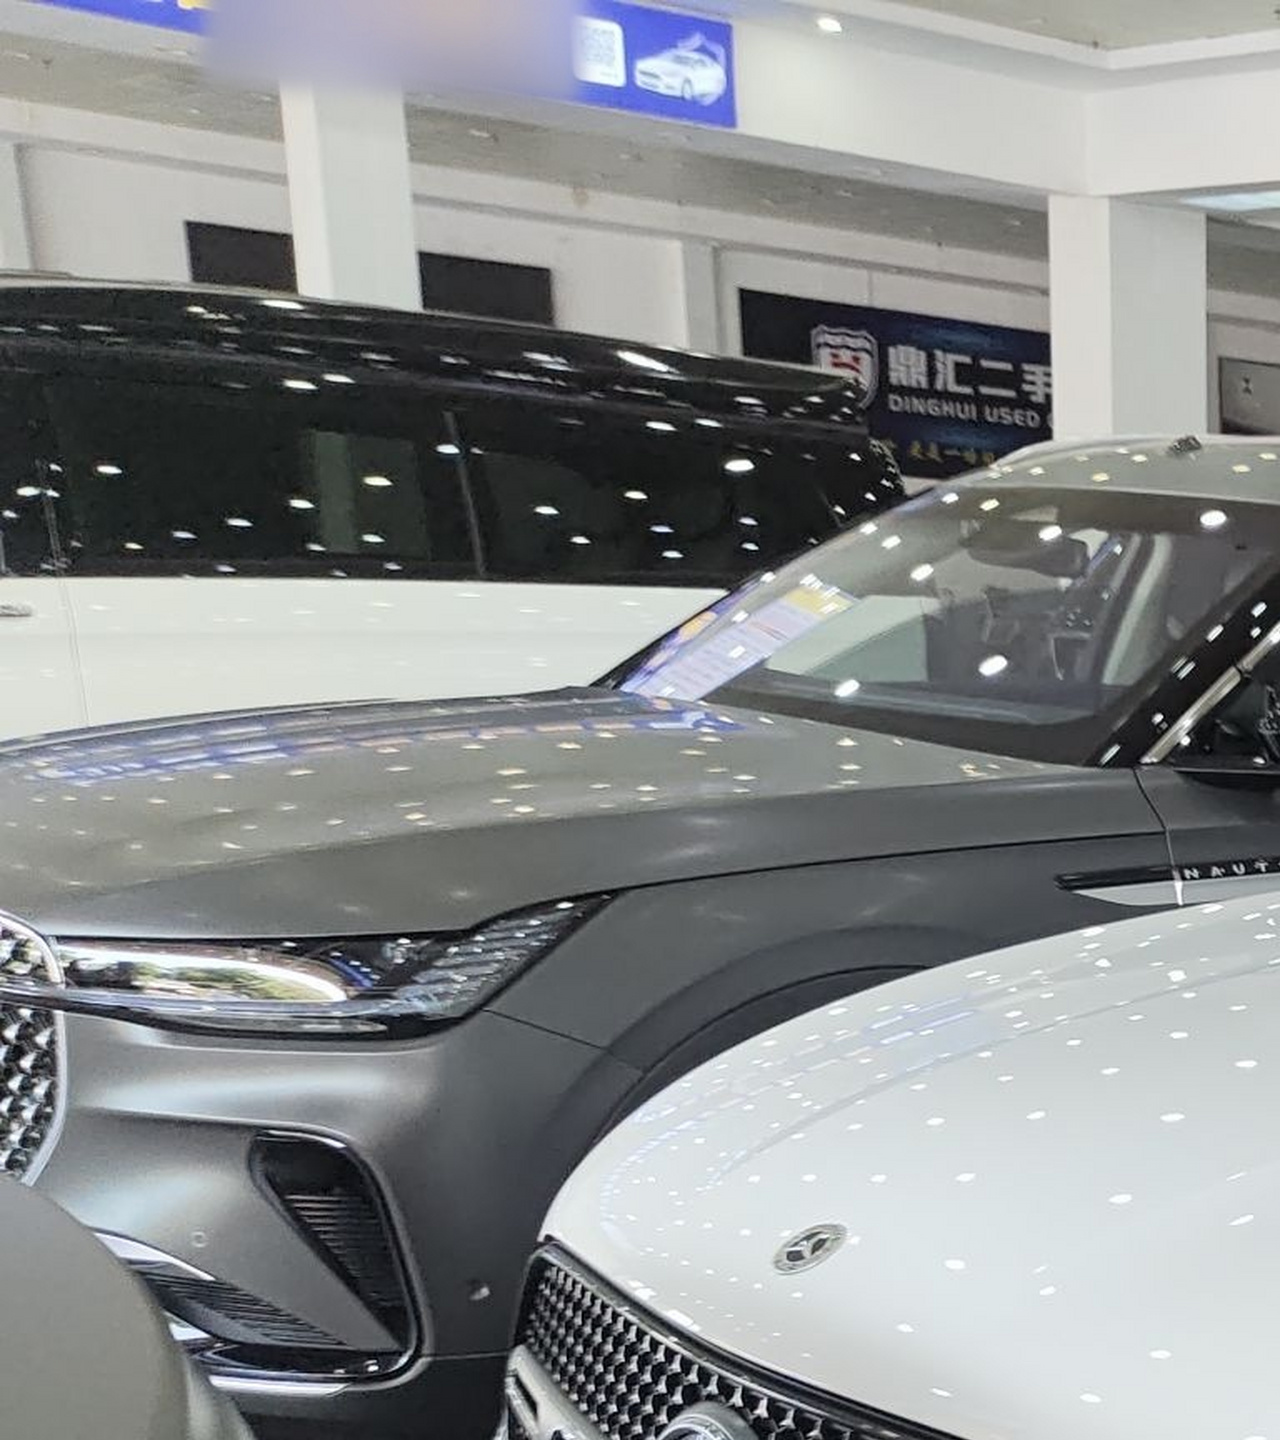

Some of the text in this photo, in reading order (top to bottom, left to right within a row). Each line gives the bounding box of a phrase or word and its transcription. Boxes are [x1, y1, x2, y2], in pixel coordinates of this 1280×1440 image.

[888, 345, 1053, 404] 鼎汇二手
[888, 393, 977, 421] DINGHUI
[985, 405, 1041, 429] USED
